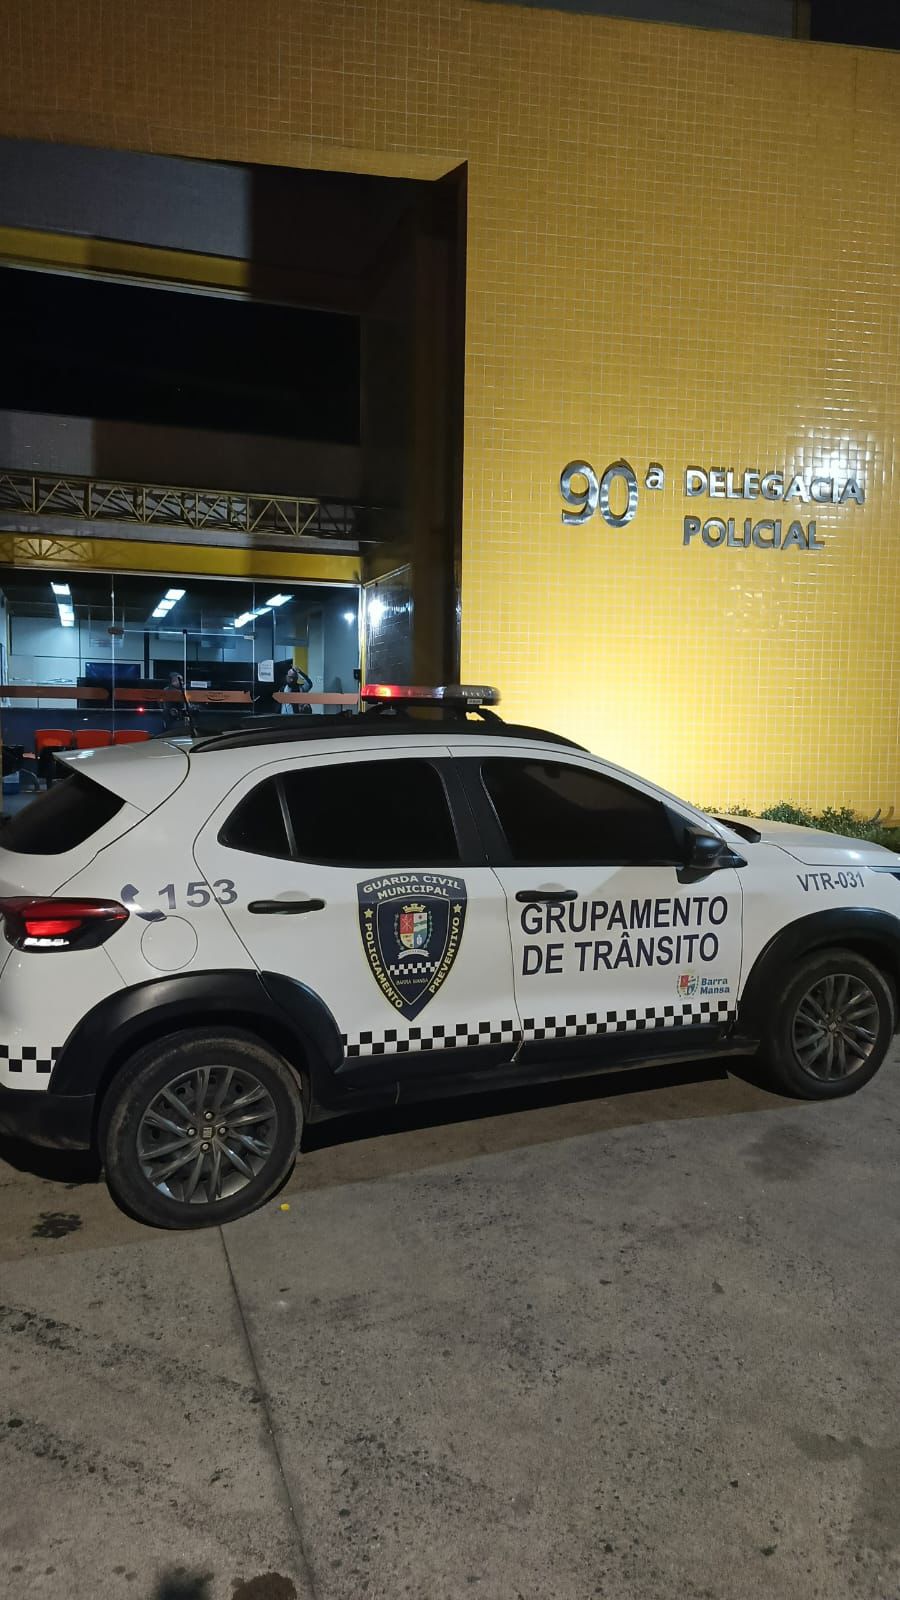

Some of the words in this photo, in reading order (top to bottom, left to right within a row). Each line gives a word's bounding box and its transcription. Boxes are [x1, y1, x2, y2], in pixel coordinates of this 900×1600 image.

[685, 465, 865, 505] DELEGACIA
[683, 515, 825, 550] POLICIAL
[158, 879, 238, 910] 153
[363, 875, 418, 893] GUARDA
[423, 875, 461, 890] CIVIL
[377, 885, 450, 900] MUNICIPAL
[796, 871, 865, 892] VTR-031
[520, 895, 729, 935] GRUPAMENTO
[364, 922, 404, 1008] POLICIAMENTO
[429, 917, 460, 994] PREVENTIVO
[522, 943, 564, 976] DE
[575, 932, 719, 972] TRÂNSITO
[700, 986, 730, 995] Mansa
[701, 977, 728, 986] Barra
